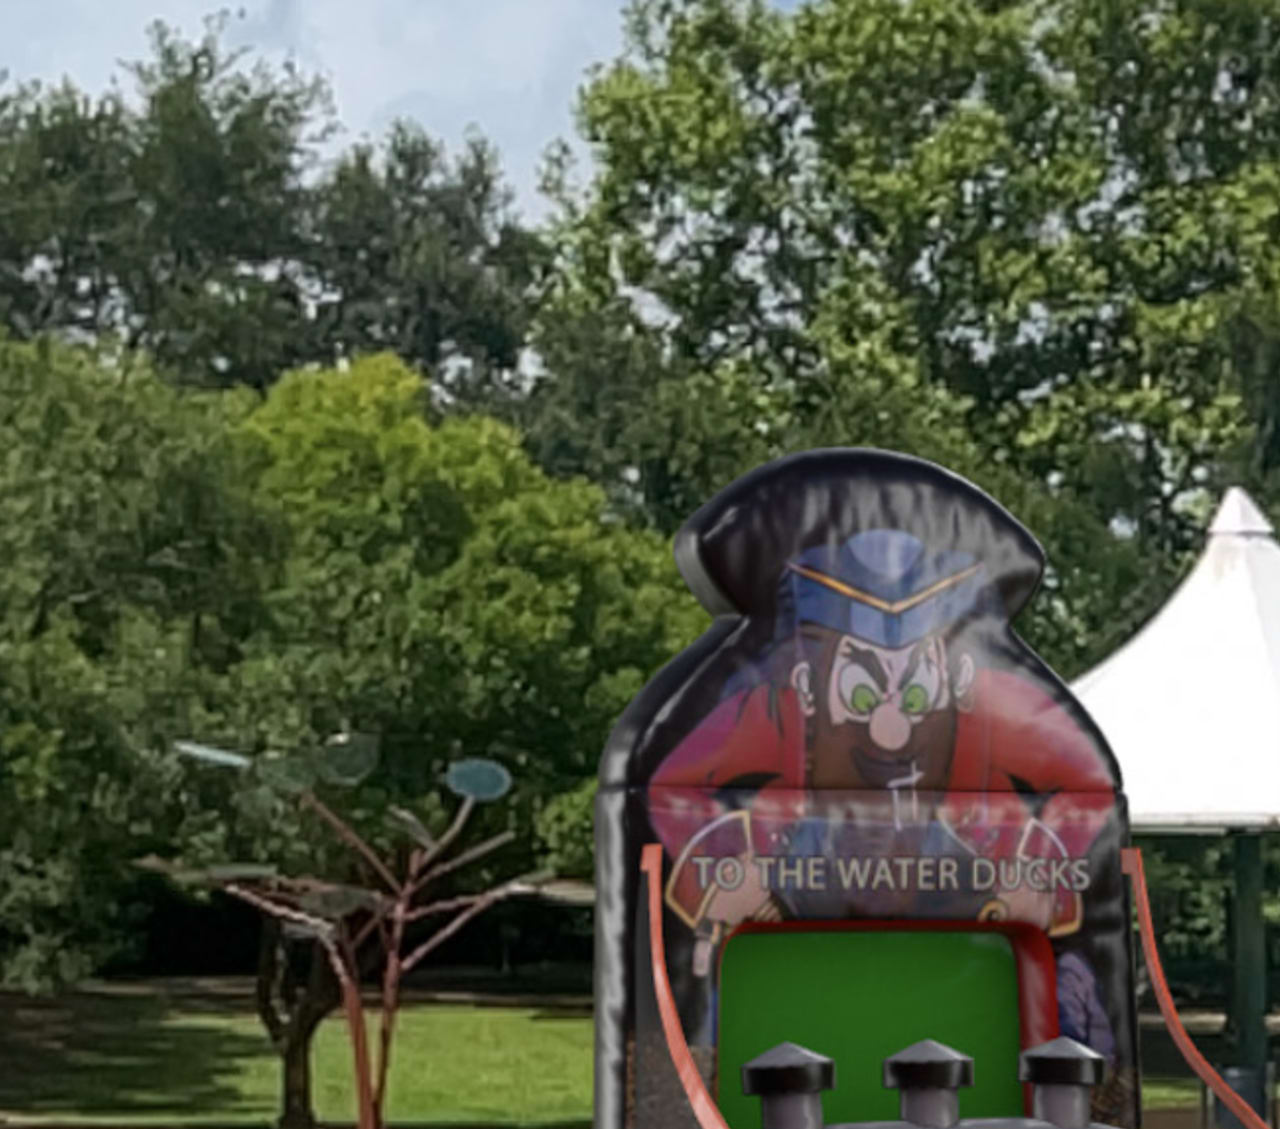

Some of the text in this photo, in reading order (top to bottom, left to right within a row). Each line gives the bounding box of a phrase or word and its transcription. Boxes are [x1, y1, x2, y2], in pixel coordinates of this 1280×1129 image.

[692, 856, 1091, 890] TO THE WATER DUCKS
